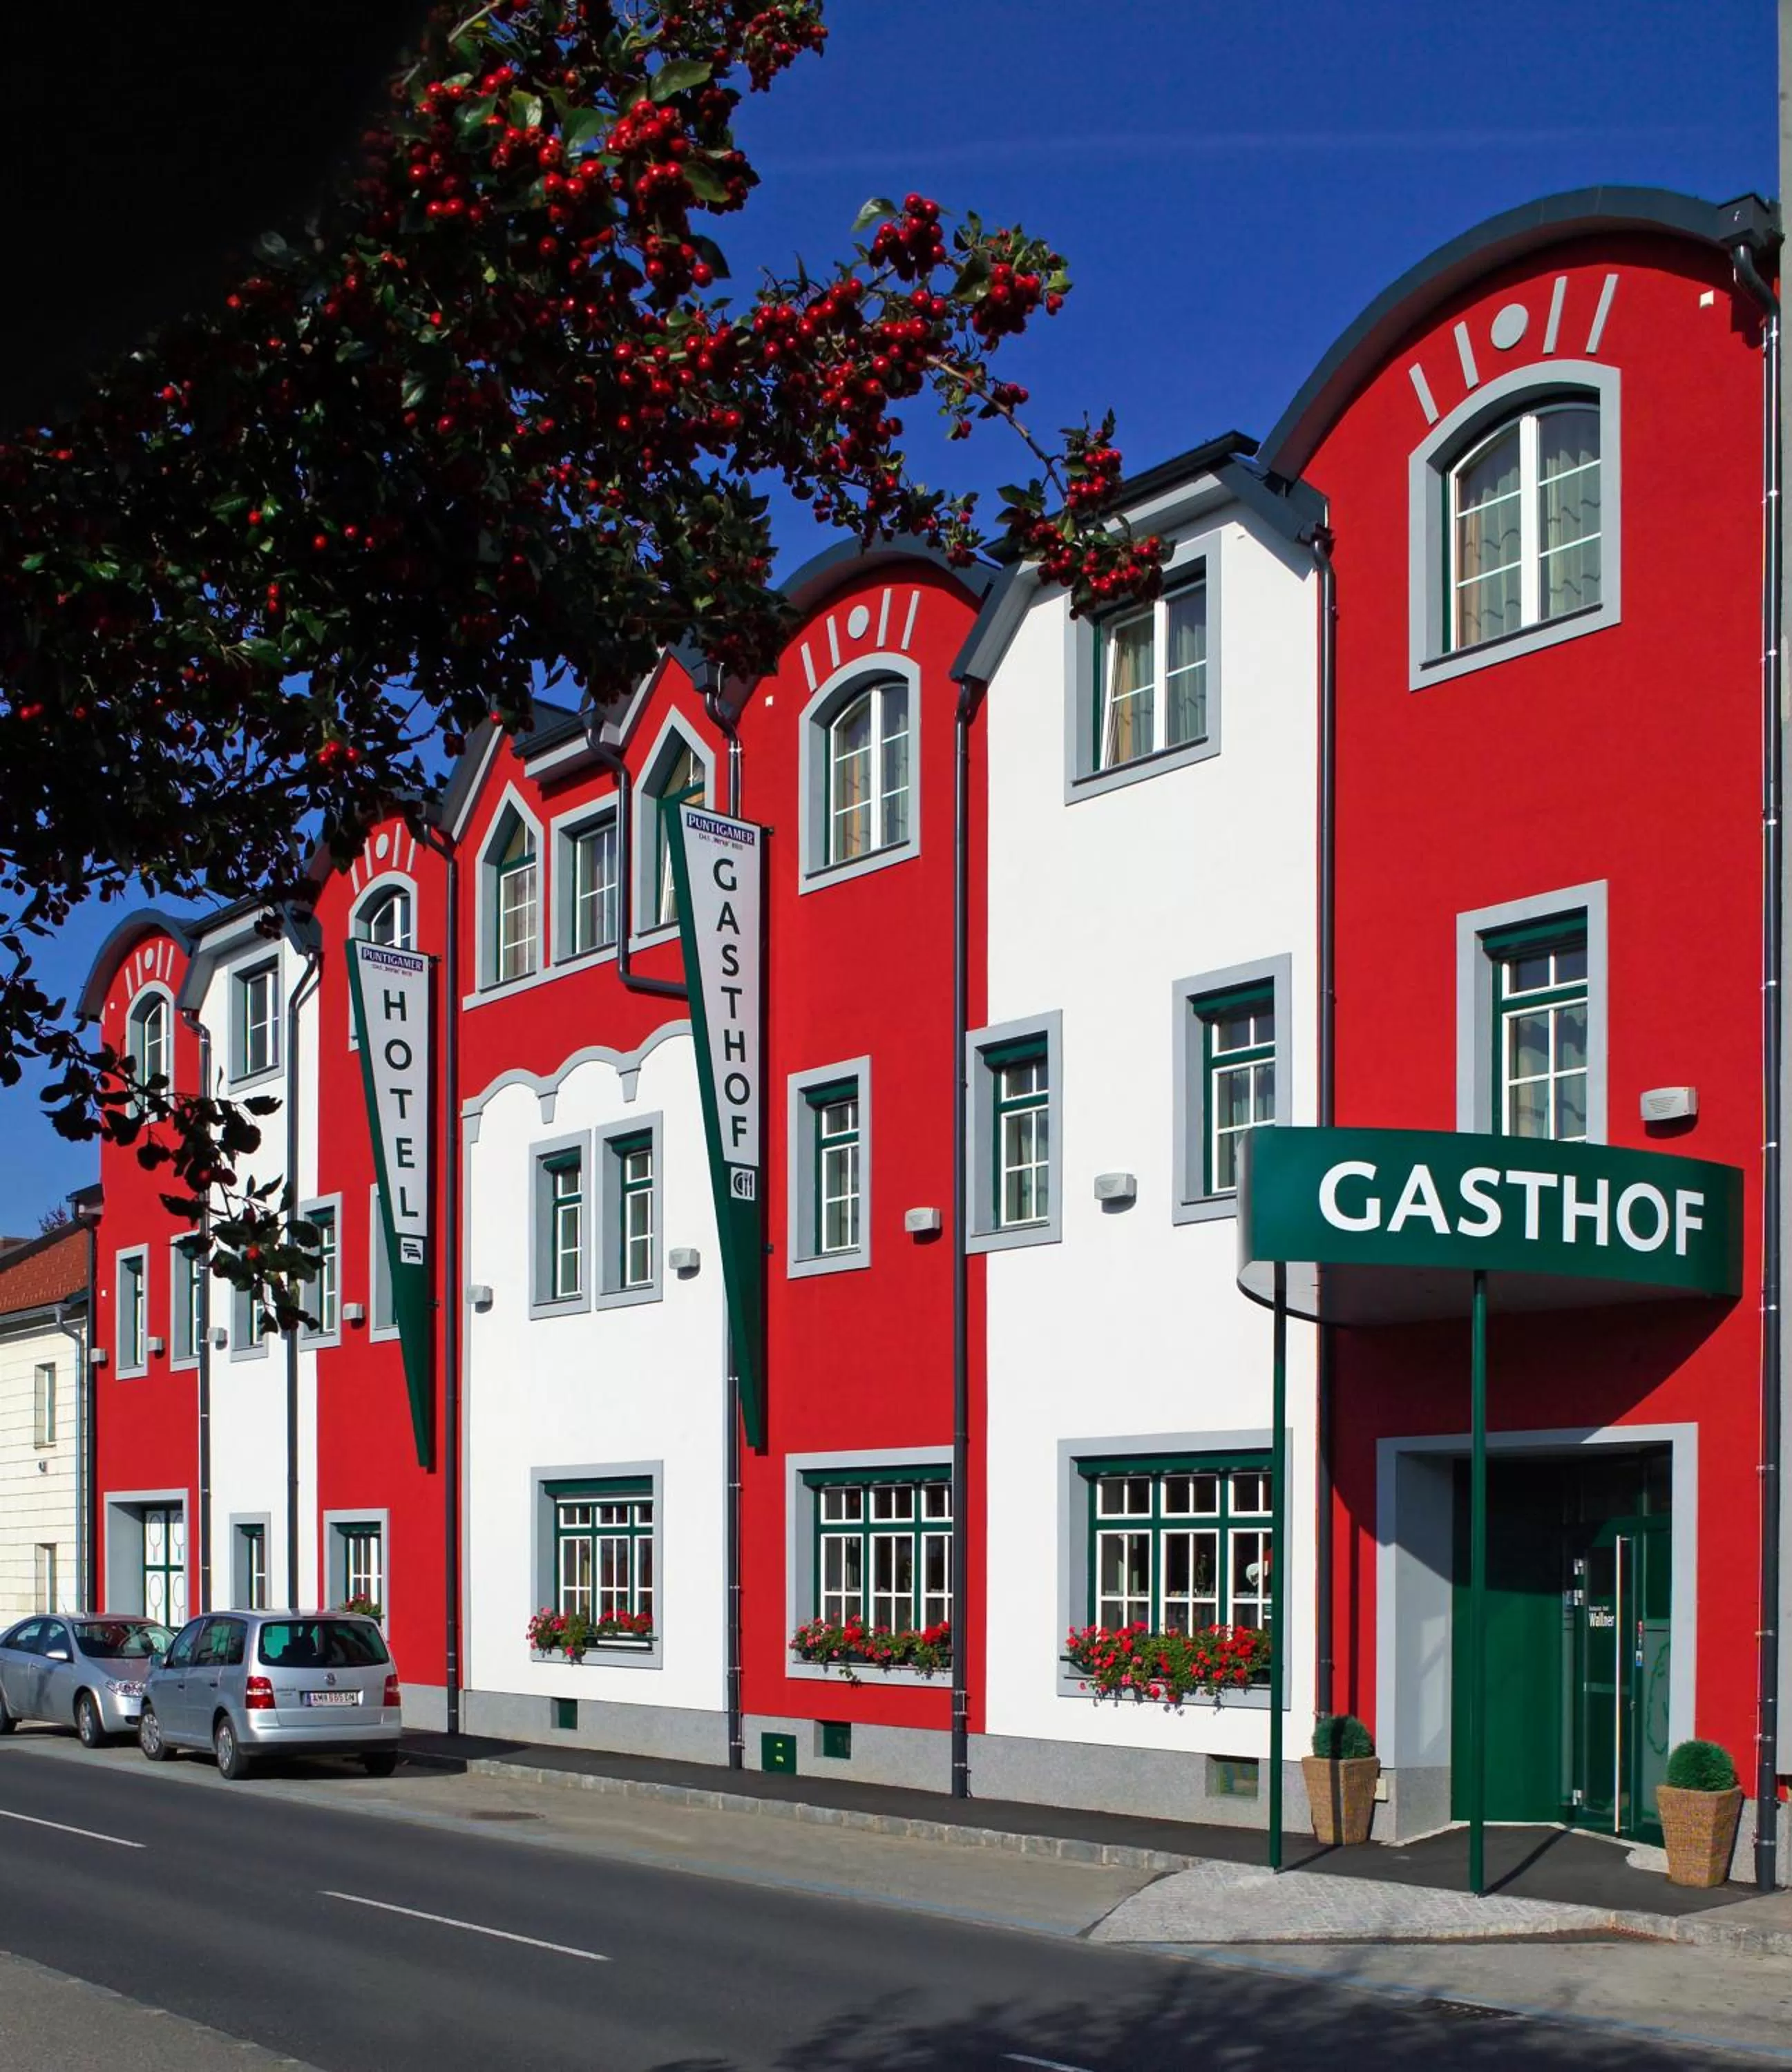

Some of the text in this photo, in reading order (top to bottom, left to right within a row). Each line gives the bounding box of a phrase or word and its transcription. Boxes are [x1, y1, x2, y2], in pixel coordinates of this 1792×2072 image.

[688, 814, 754, 844] PUNTIGAMER
[363, 948, 423, 970] PUNTIGAMER
[713, 858, 750, 1147] GASTHOF
[383, 989, 419, 1218] HOTEL
[1319, 1161, 1705, 1256] GASTHOF
